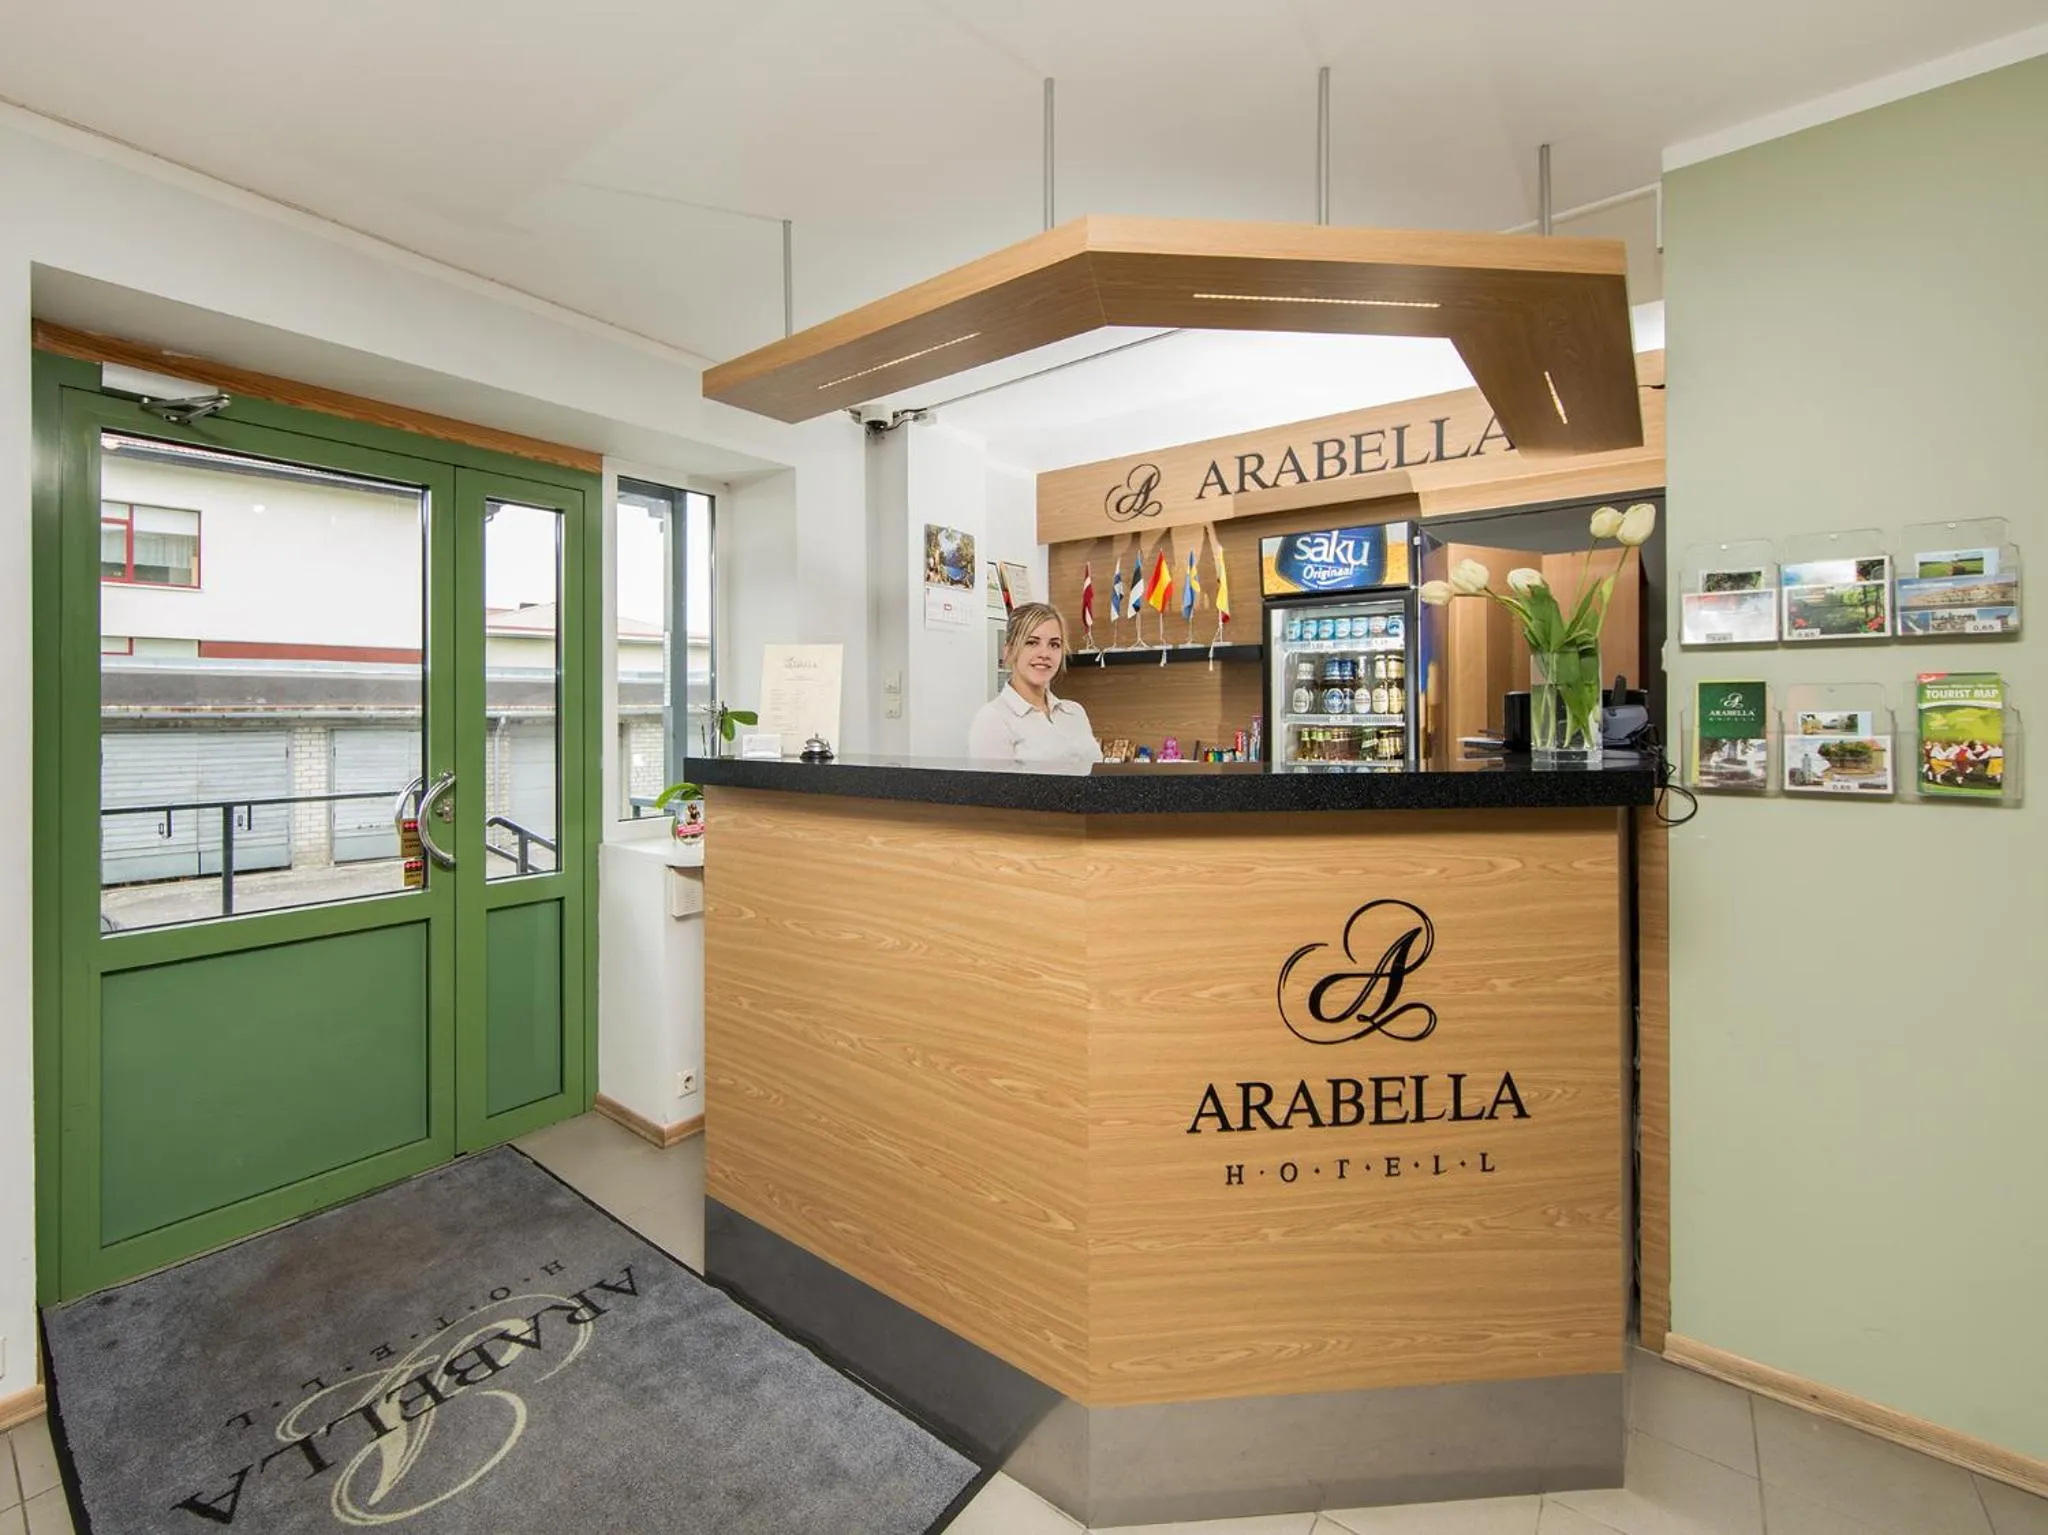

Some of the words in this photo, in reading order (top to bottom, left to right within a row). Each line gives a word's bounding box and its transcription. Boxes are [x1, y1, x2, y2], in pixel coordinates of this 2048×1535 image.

[1195, 412, 1516, 500] ARABELLA
[1925, 689, 1970, 699] TOURIST
[1974, 688, 1999, 699] MAP
[1186, 1071, 1532, 1133] ARABELLA
[170, 1264, 641, 1525] ARABELLA
